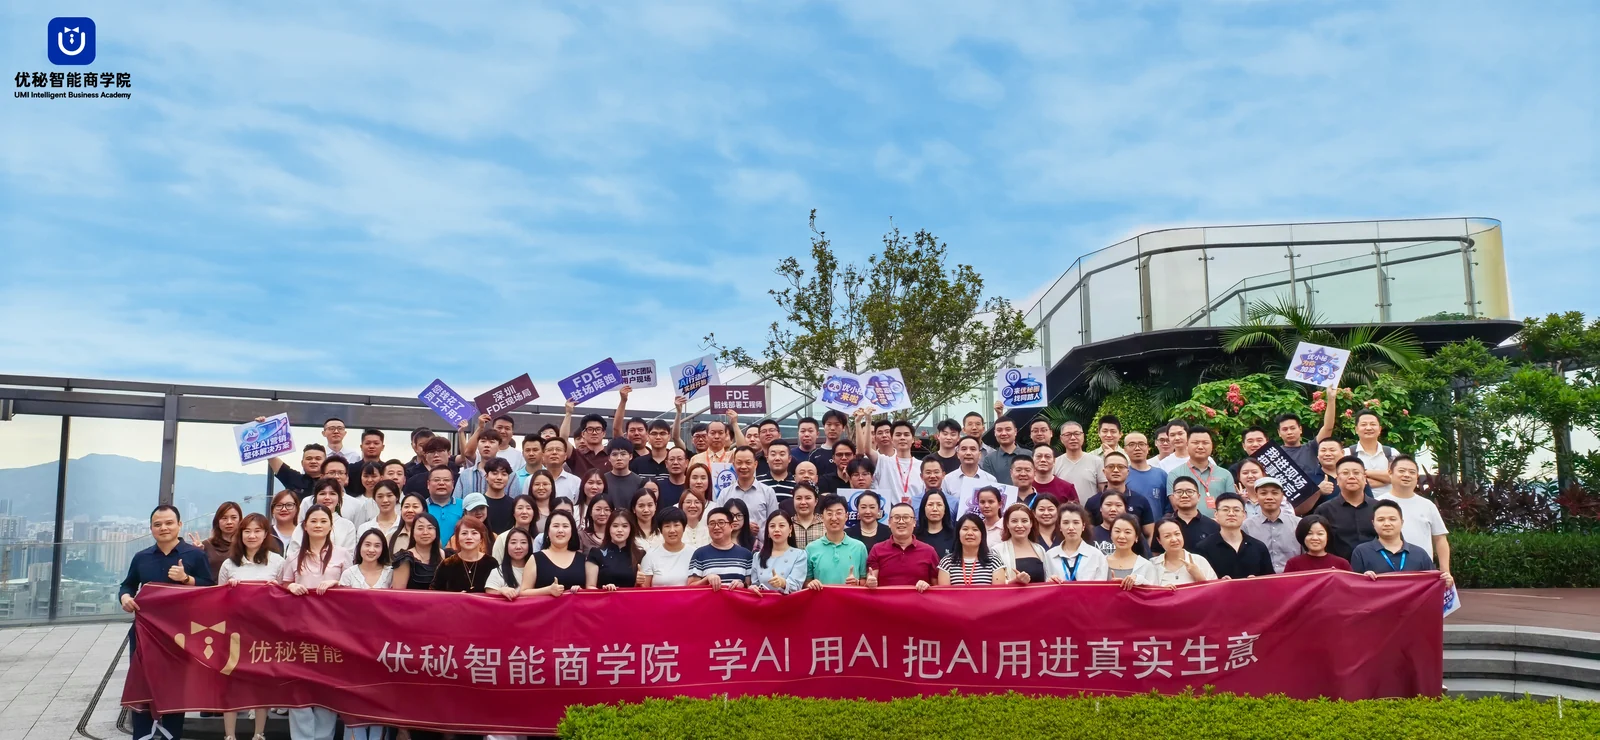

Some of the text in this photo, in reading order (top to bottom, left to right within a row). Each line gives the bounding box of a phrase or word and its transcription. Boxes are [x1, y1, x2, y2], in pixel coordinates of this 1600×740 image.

[572, 367, 603, 388] FDE
[618, 367, 653, 377] 建FDE团队
[492, 385, 517, 403] 深圳
[570, 373, 617, 403] 驻场陪跑
[726, 390, 750, 400] FDE
[431, 384, 465, 411] 您钱花了
[486, 388, 532, 416] FDE现场局
[713, 400, 763, 409] 前线部署工程师
[841, 392, 858, 404] 来啦
[1013, 393, 1040, 402] 找同路人
[243, 434, 287, 452] 企业AI营销
[244, 441, 290, 459] 整体解决方案
[1264, 446, 1308, 490] 我进现场
[720, 473, 733, 482] 今天
[249, 640, 344, 665] 优秘智能
[377, 631, 1260, 686] 优秘智能商学院 学AI 用AI 把AI用进真实生意
